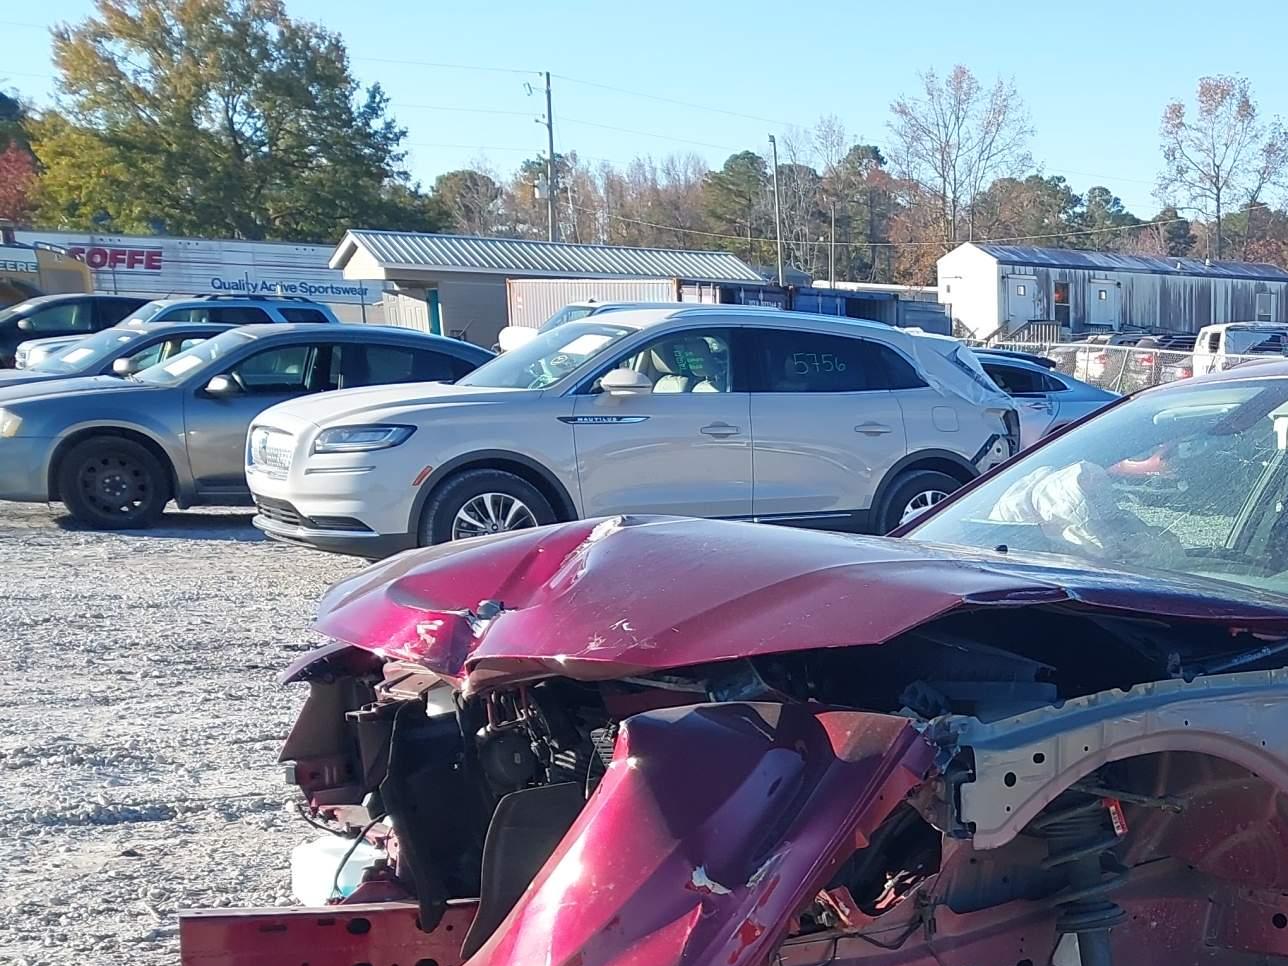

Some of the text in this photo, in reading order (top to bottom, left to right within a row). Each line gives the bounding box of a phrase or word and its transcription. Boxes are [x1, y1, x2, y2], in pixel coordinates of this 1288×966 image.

[211, 278, 258, 293] Quality
[300, 282, 368, 296] Sportswear
[792, 352, 847, 375] 5756
